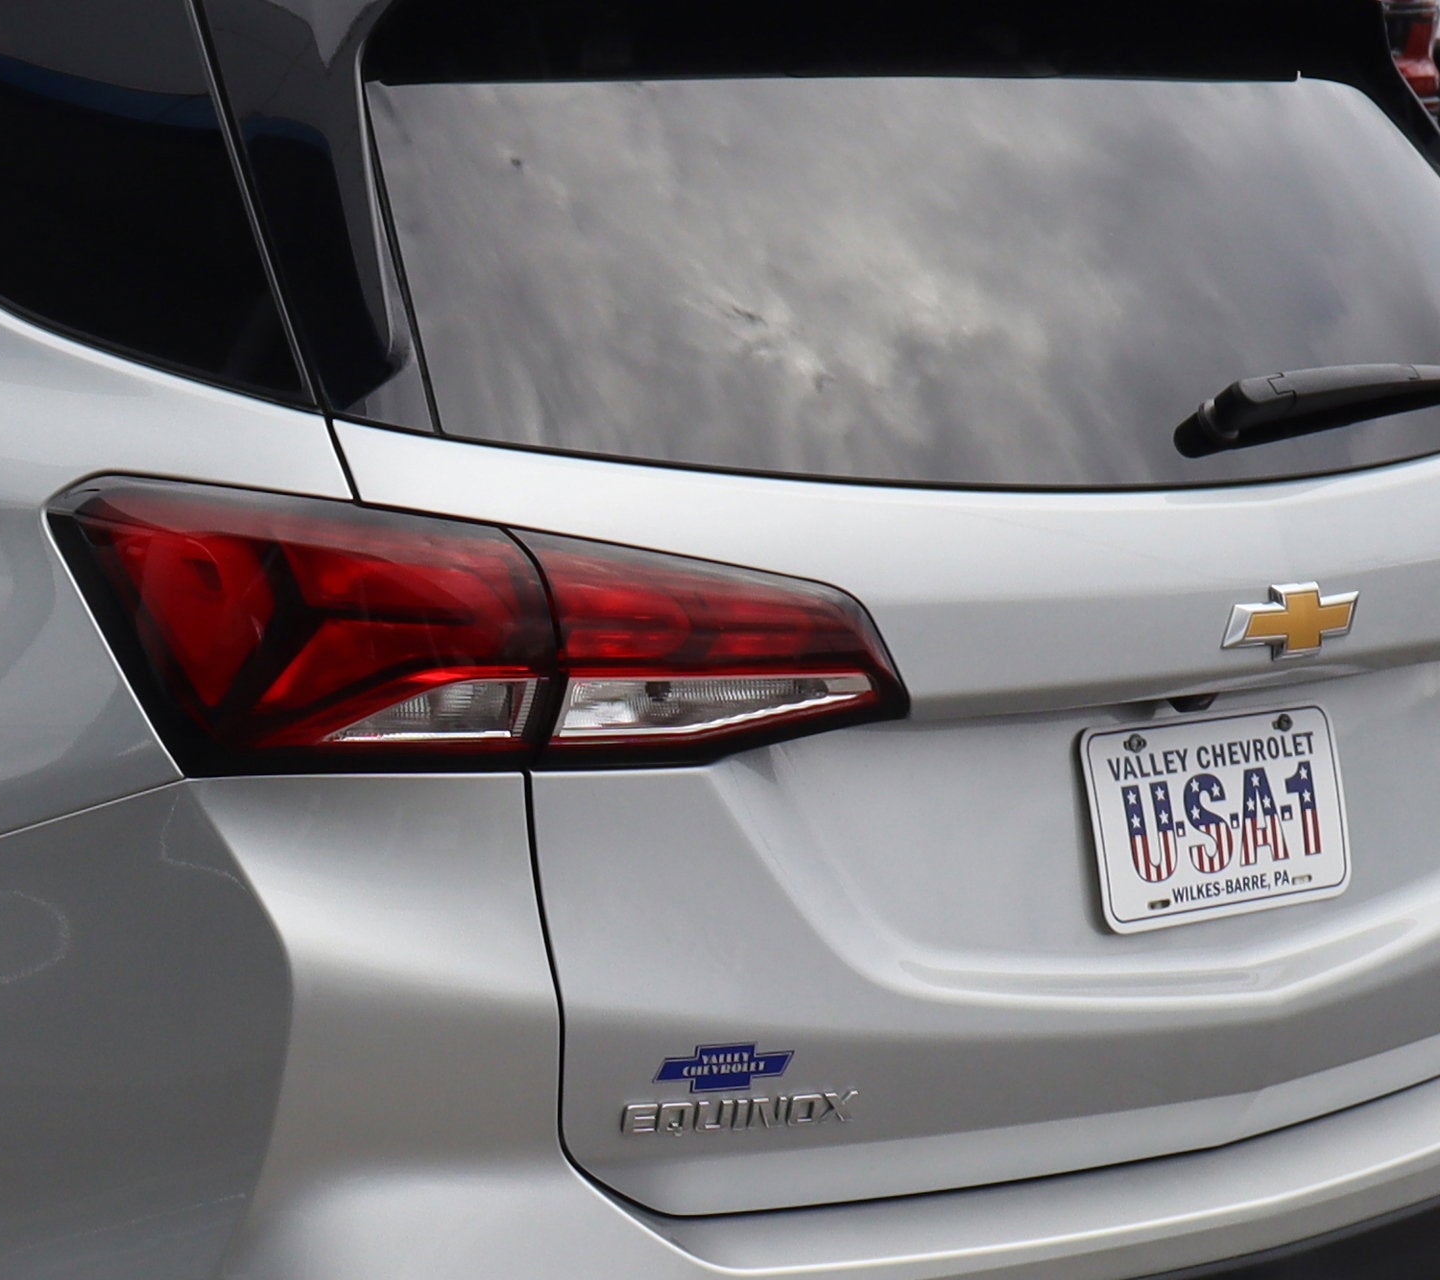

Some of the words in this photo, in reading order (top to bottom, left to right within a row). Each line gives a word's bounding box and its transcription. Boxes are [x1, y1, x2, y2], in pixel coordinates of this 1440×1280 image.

[1106, 748, 1189, 782] VALLEY
[1196, 731, 1315, 771] CHEVROLET
[1172, 874, 1272, 904] WILKES-BARRE,
[1274, 869, 1291, 887] PA
[682, 1061, 766, 1077] CHEVROLET
[701, 1051, 750, 1065] VALLEY
[621, 1089, 859, 1137] EQUINOX
